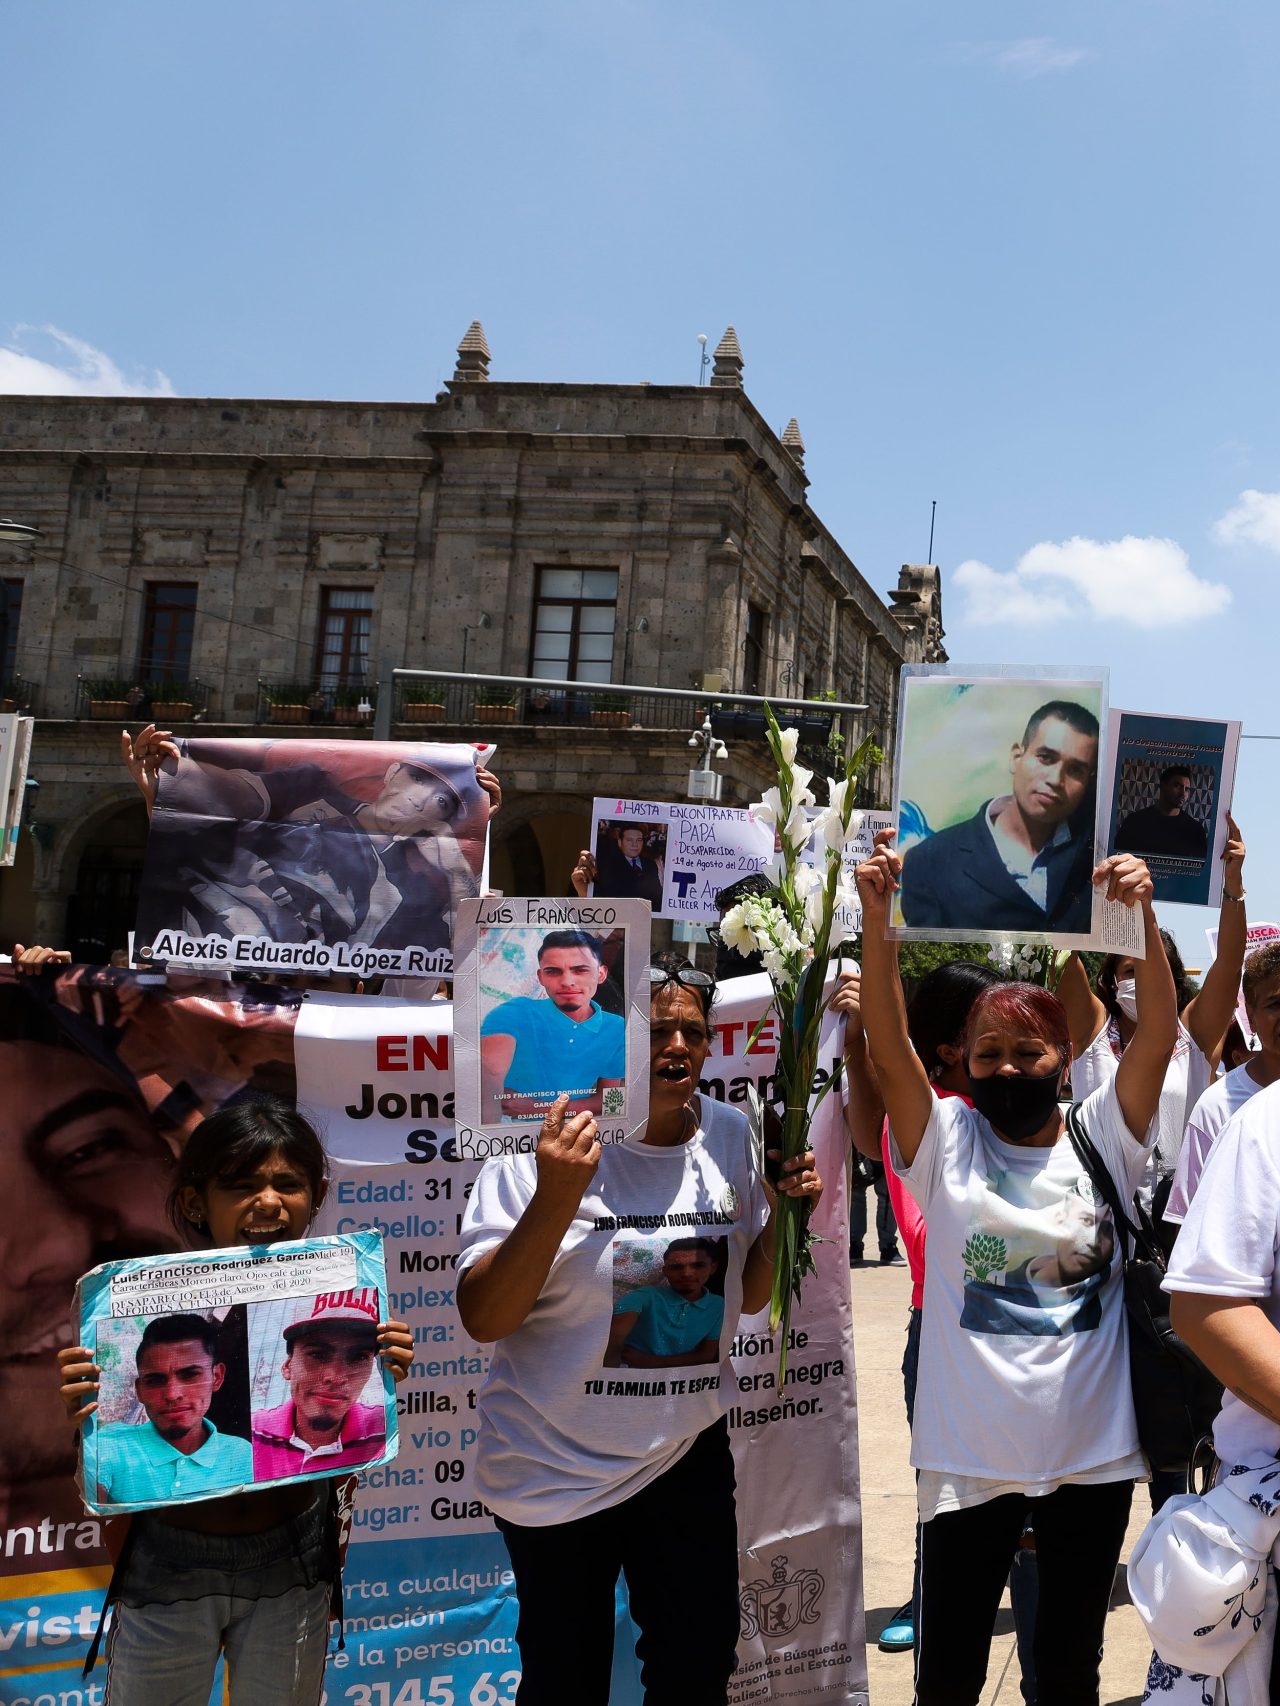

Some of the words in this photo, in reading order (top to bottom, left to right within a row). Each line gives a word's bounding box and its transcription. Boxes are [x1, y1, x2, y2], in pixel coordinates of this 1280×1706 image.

[686, 859, 694, 868] de
[696, 859, 724, 871] Agosto
[725, 861, 736, 870] del
[700, 880, 723, 899] Am
[475, 900, 514, 925] LUIS
[526, 899, 617, 925] FRANCISCO
[156, 933, 228, 960] Alexis
[235, 939, 331, 967] Eduardo
[337, 944, 402, 974] López
[408, 950, 454, 973] Ruiz
[493, 1093, 512, 1101] LUIS
[513, 1090, 556, 1099] FRANCISCO
[459, 1127, 539, 1161] RODRIGU
[337, 1180, 414, 1205] Edad:
[424, 1178, 452, 1202] 31
[336, 1214, 445, 1239] Cabello:
[594, 1216, 615, 1232] LUIS
[616, 1214, 667, 1230] FRANCISCO
[111, 1273, 139, 1285] Luis
[140, 1264, 210, 1281] Francisco
[180, 1276, 217, 1287] Moreno
[219, 1273, 242, 1283] claro
[246, 1271, 269, 1283] Ojos
[290, 1266, 312, 1277] claro
[233, 1285, 265, 1296] Agosto
[272, 1279, 287, 1290] del
[288, 1278, 311, 1289] 2020
[783, 1359, 844, 1386] negra
[584, 1380, 604, 1395] TU
[606, 1381, 667, 1397] FAMILIA
[670, 1379, 686, 1395] TE
[396, 1391, 458, 1416] clilla,
[729, 1396, 824, 1429] llaseñor.
[411, 1427, 451, 1450] vio
[356, 1465, 425, 1490] echa:
[434, 1460, 465, 1484] 09
[352, 1504, 420, 1532] ugar:
[398, 1564, 516, 1596] cualquie
[0, 1605, 112, 1650] vist
[359, 1643, 386, 1667] la
[396, 1637, 513, 1669] persona:
[764, 1654, 781, 1666] de
[783, 1641, 848, 1663] Búsqueda
[784, 1662, 806, 1676] del
[808, 1654, 853, 1672] Estado
